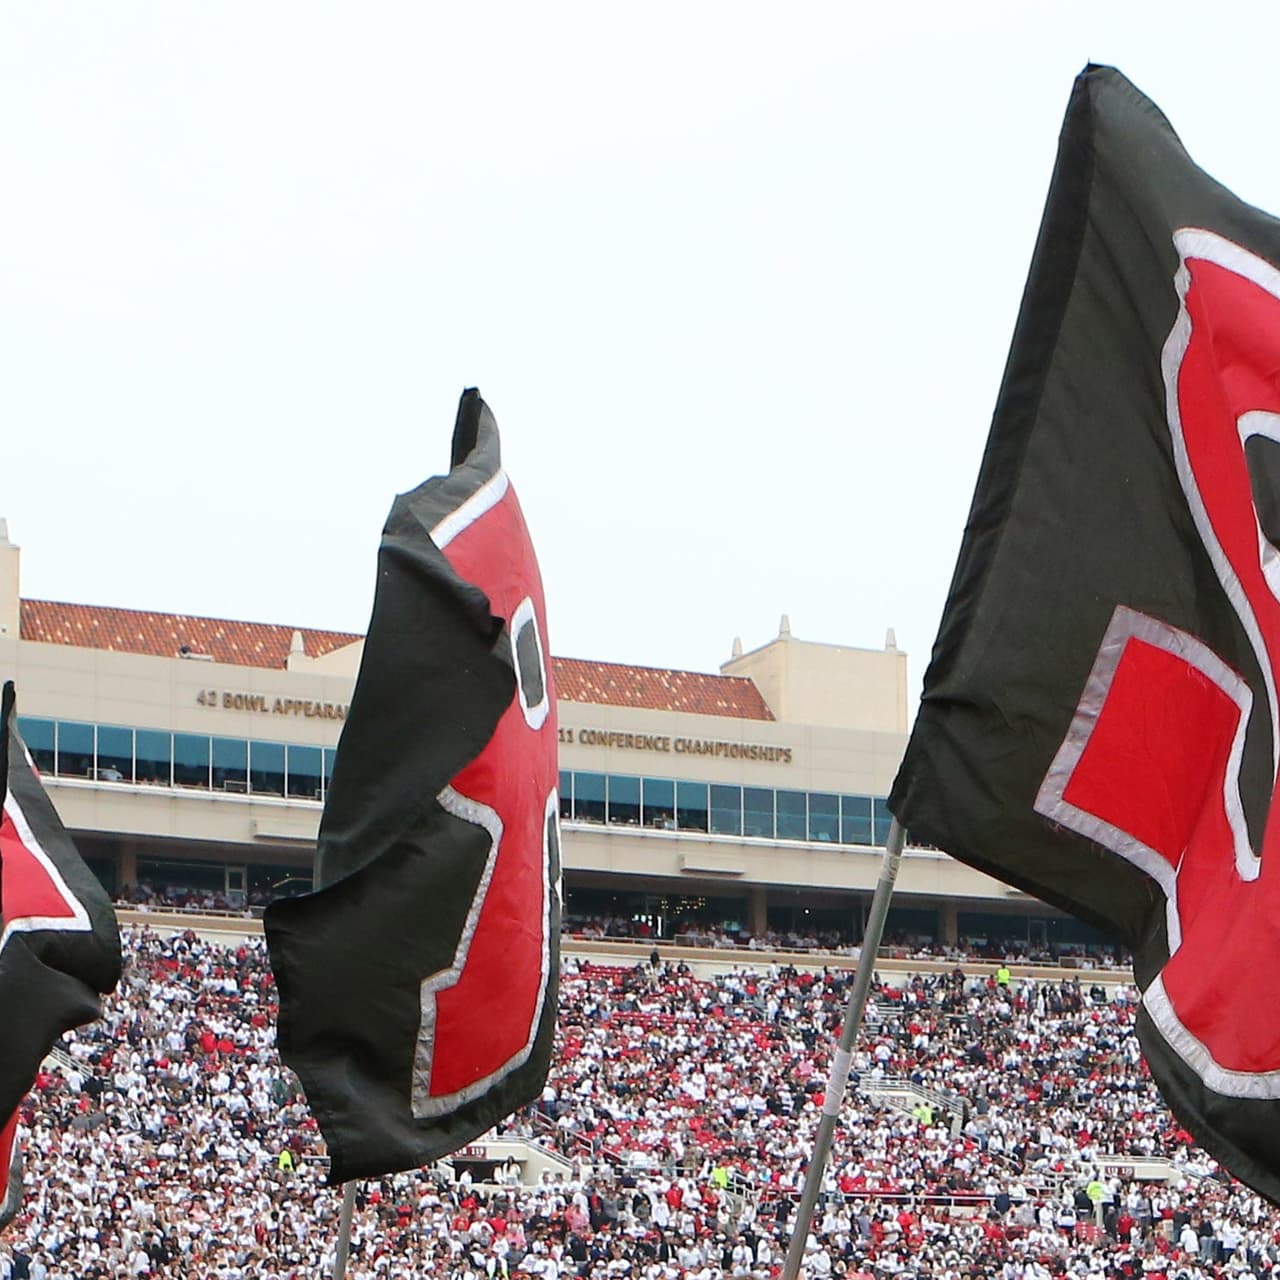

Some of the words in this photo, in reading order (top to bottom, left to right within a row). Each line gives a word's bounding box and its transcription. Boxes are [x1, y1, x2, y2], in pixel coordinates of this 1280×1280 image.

[222, 692, 269, 713] BOWL
[579, 729, 670, 753] CONFERENCE
[673, 738, 793, 764] CHAMPIONSHIPS
